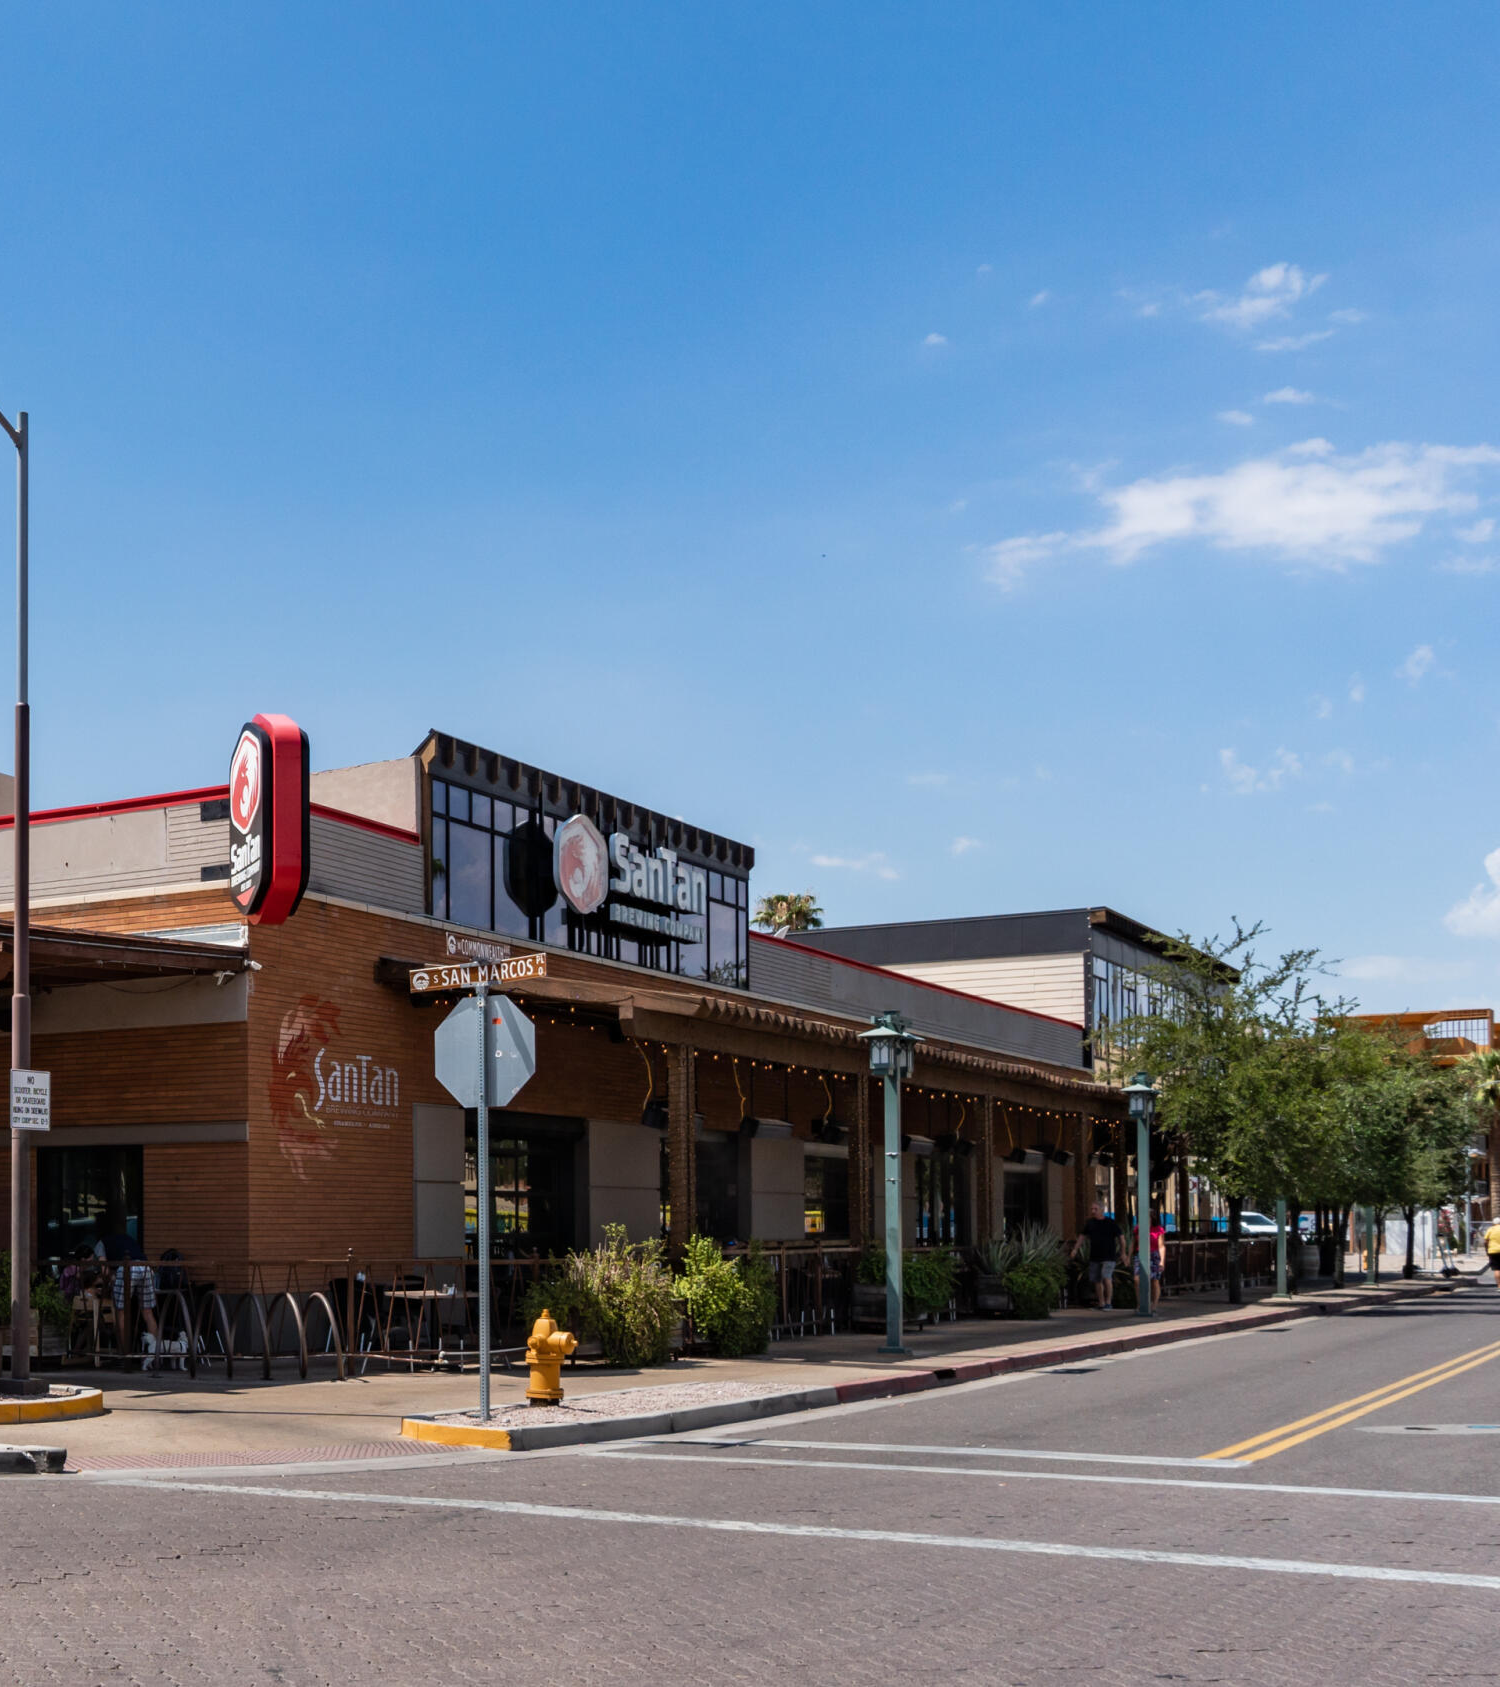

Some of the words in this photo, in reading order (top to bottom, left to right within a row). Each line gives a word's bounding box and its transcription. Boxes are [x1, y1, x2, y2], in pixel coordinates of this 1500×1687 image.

[231, 833, 260, 875] SanTan
[609, 832, 707, 916] SanTan
[610, 903, 660, 932] BREWING
[661, 916, 706, 944] COMPANY
[433, 974, 439, 984] S
[441, 967, 470, 986] SAN
[478, 958, 534, 982] MARCOS
[536, 954, 545, 965] PL
[27, 1076, 34, 1085] NO
[313, 1047, 399, 1111] SanTan
